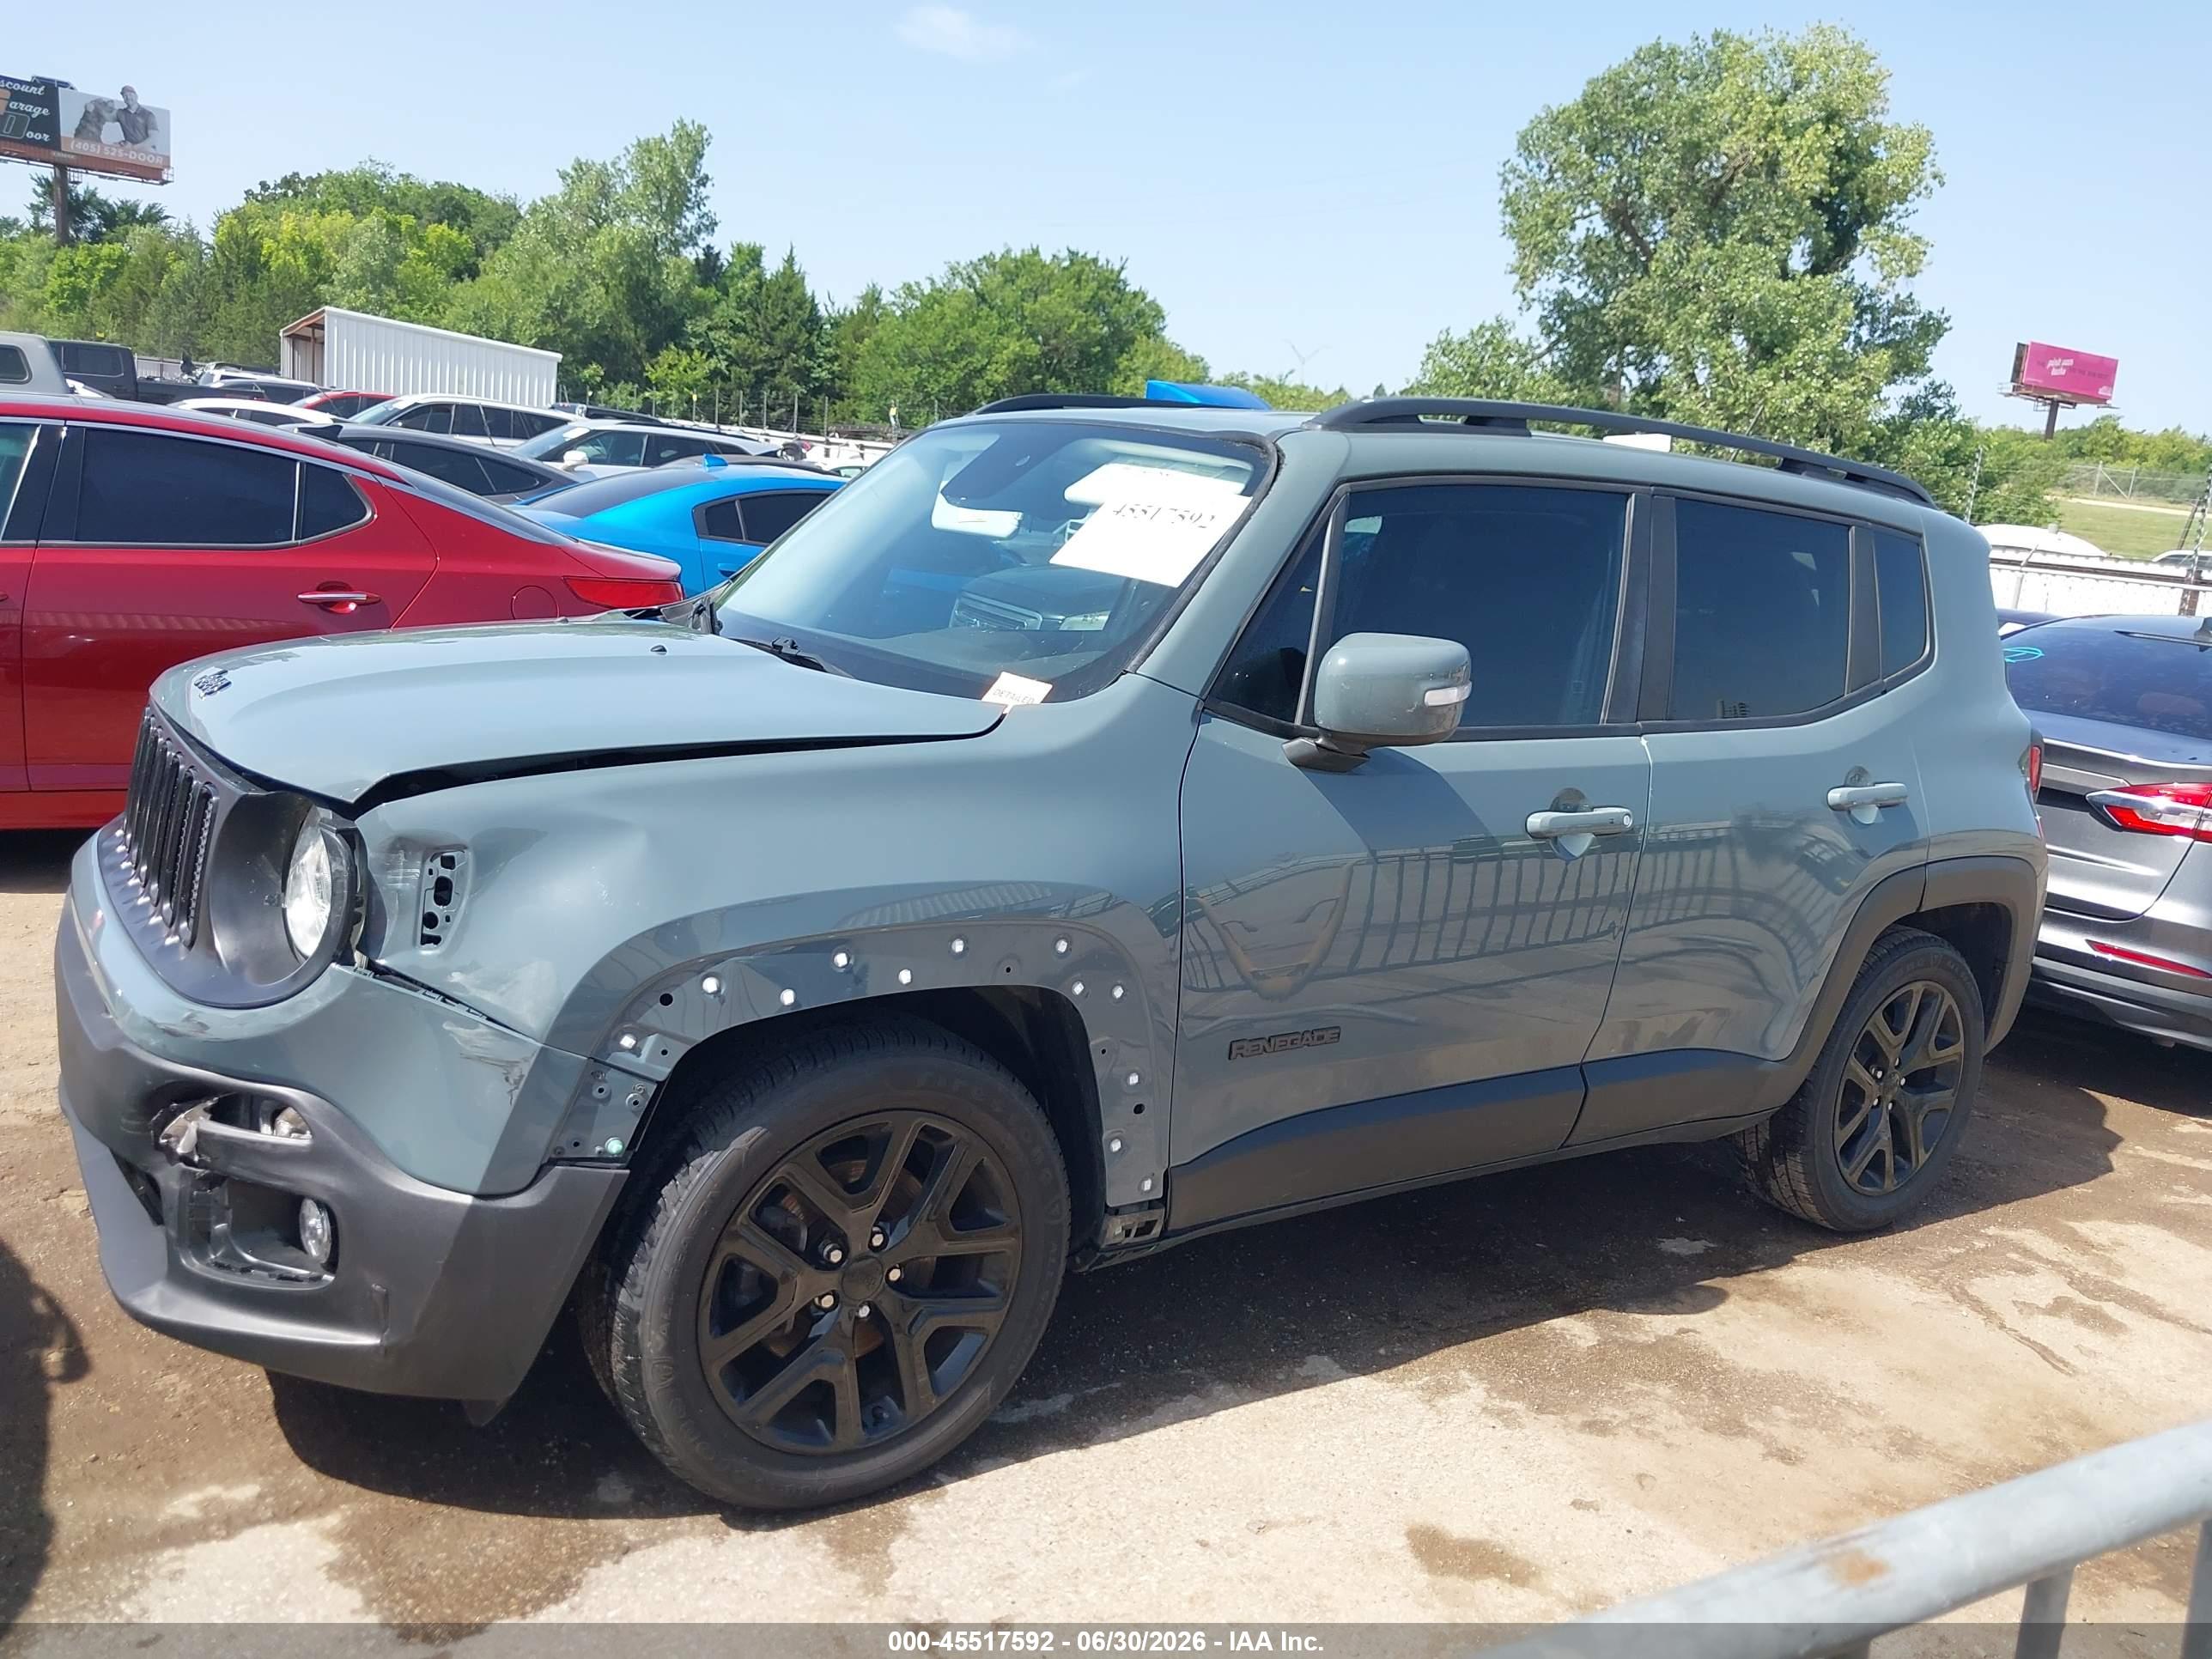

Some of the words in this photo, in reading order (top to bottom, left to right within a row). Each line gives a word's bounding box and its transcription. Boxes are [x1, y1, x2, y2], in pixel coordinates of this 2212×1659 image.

[70, 139, 100, 155] (405)
[103, 146, 164, 165] 525-DOOR
[1228, 1026, 1341, 1060] RENEGADE
